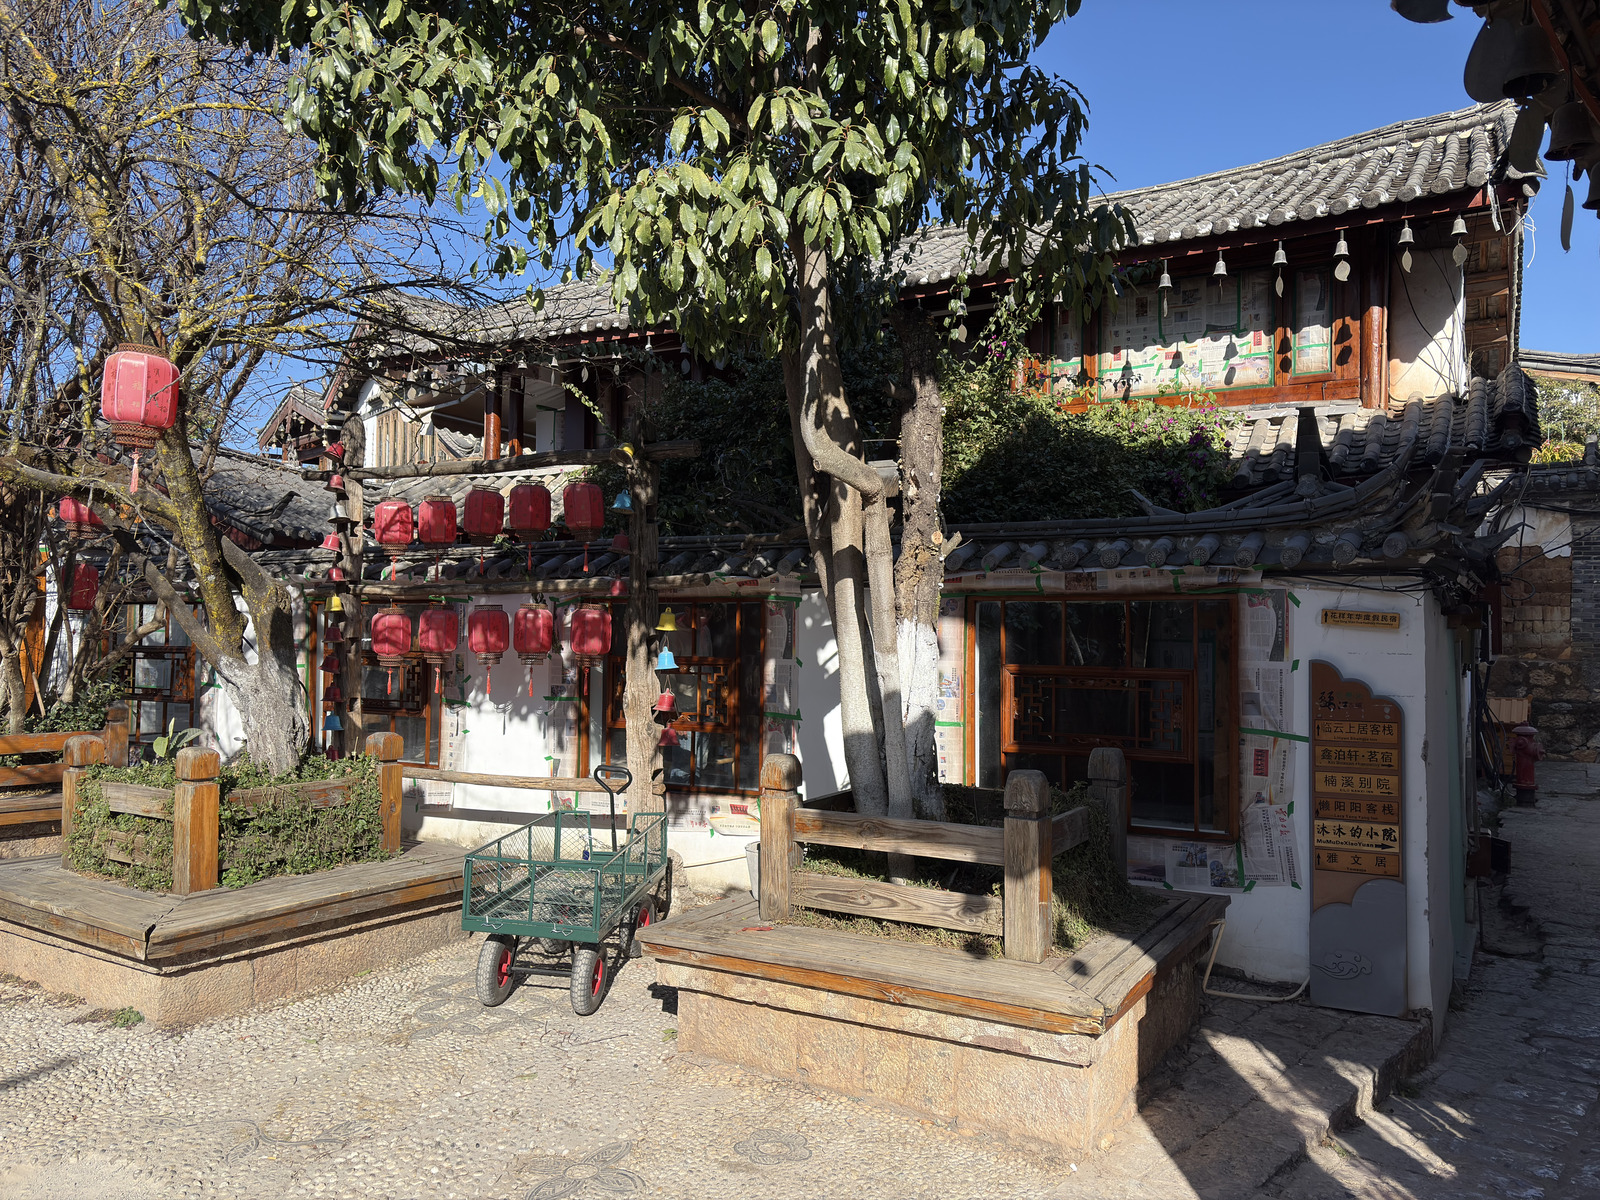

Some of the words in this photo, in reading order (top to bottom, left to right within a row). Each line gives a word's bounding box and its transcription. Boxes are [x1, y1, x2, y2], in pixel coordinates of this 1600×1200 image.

[1330, 612, 1397, 623] 花样年华度假民宿
[1322, 722, 1394, 737] 临云上居客栈
[1320, 747, 1393, 763] 鑫泊轩·茗宿
[1324, 774, 1391, 790] 楠溪别院
[1318, 799, 1395, 816] 懒阳阳客栈
[1316, 822, 1397, 843] 沐沐的小院
[1316, 838, 1374, 848] MuMuDeXiaoYuan
[1326, 852, 1387, 868] 雅文居
